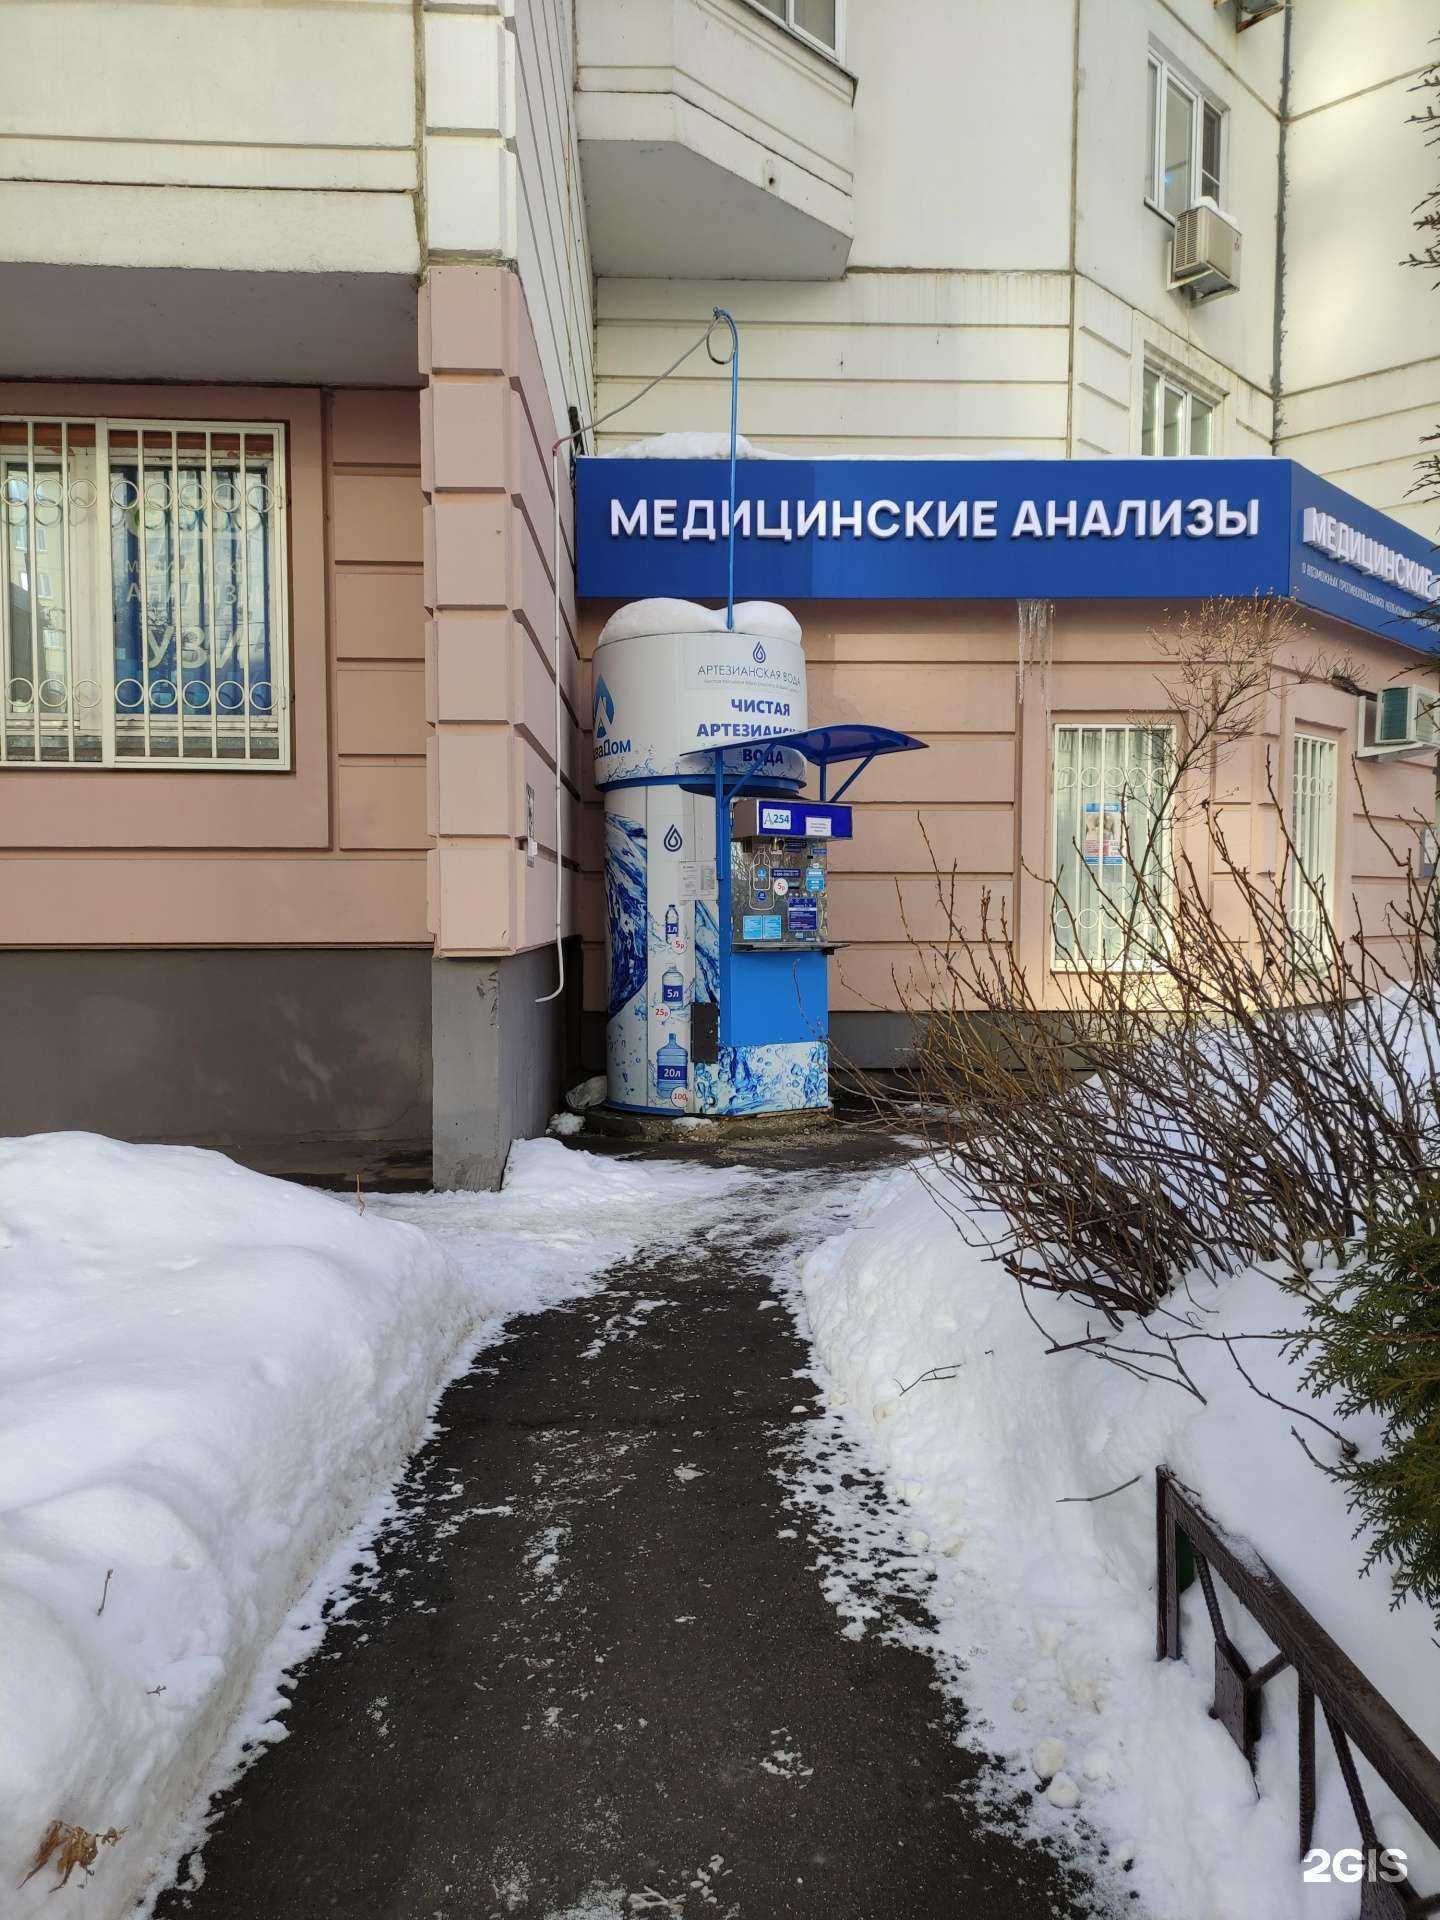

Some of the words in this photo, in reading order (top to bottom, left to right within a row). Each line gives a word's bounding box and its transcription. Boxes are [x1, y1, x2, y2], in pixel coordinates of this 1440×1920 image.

[610, 499, 998, 541] МЕДИЦИНСКИЕ
[1011, 498, 1260, 539] АНАЛИЗЫ
[1303, 506, 1433, 602] МЕДИЦИНСКИЕ
[697, 664, 781, 681] АРТЕЗИАНСКАЯ
[782, 671, 801, 687] ВОДА
[731, 698, 790, 717] ЧИСТАЯ
[742, 748, 784, 766] ВОДА
[667, 989, 679, 998] 5л
[663, 1068, 681, 1078] 20л
